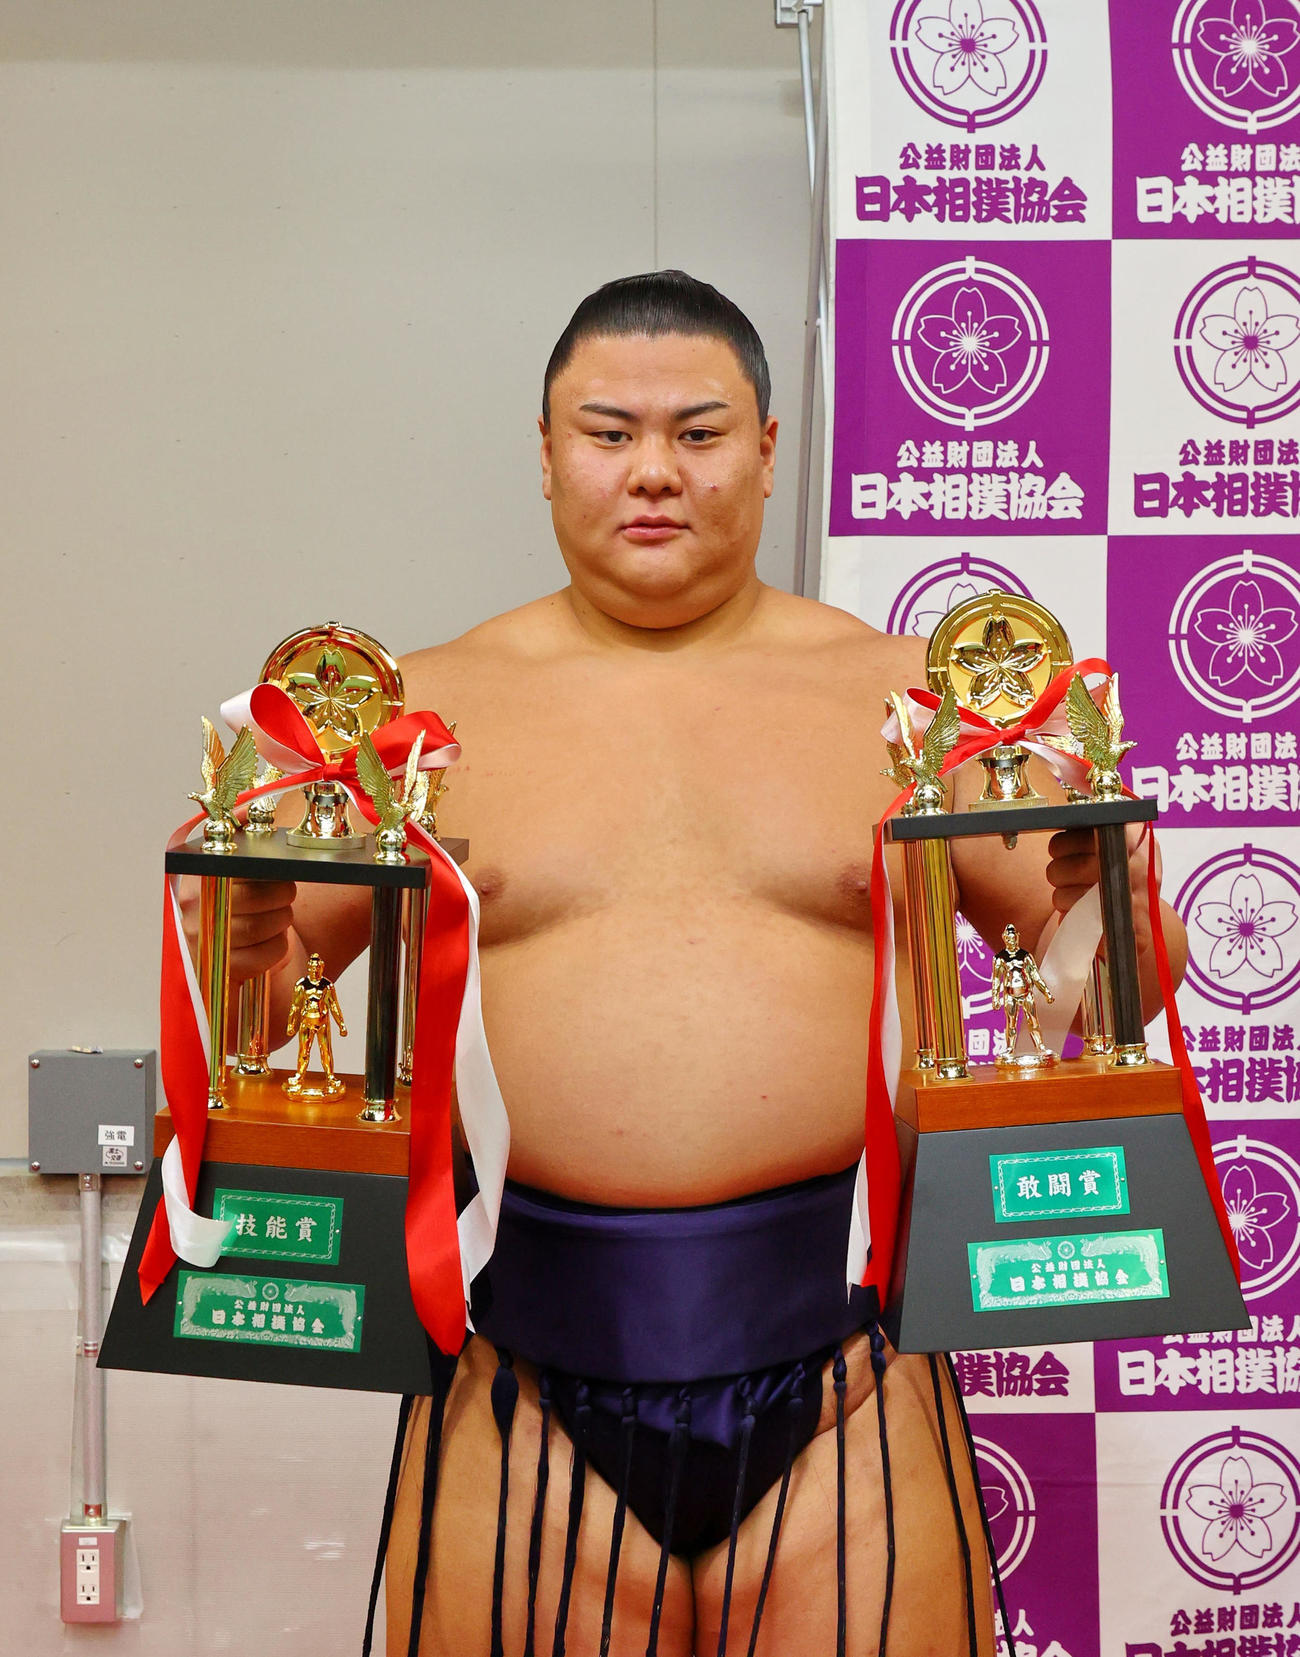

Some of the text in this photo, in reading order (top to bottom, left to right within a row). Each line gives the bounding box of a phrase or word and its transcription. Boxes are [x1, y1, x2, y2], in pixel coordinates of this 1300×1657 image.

[900, 142, 1046, 171] 公益財団法人
[856, 174, 1088, 224] 日本相撲協会
[1136, 175, 1300, 224] 日本相撲
[896, 439, 1044, 468] 公益財団法人
[1179, 439, 1300, 466] 公益財団法
[851, 471, 1085, 520] 日本相撲協会
[1134, 470, 1300, 519] 日本相撲
[1176, 732, 1298, 761] 公益財団法
[1016, 1169, 1101, 1200] 敢闘賞
[235, 1213, 318, 1242] 技能賞
[1031, 1258, 1106, 1273] 公益財団法人
[1009, 1268, 1129, 1293] 日本相撲協会
[212, 1308, 325, 1334] 日本相撲協会
[234, 1299, 305, 1315] 公益財団法人
